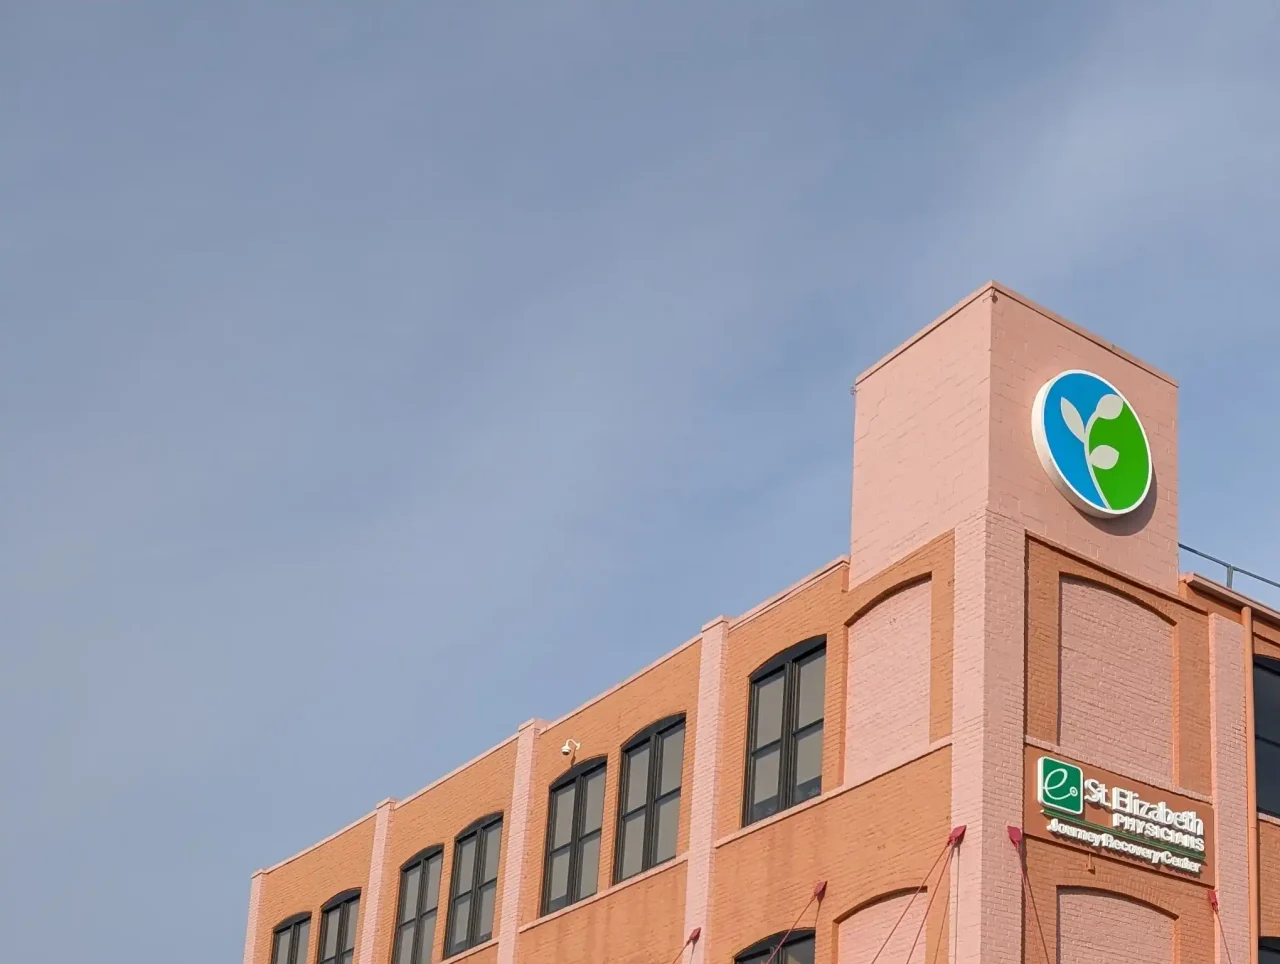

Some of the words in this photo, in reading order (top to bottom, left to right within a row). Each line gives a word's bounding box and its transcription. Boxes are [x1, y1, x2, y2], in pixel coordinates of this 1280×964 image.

[1111, 786, 1204, 836] Elizabeth
[1112, 813, 1205, 852] PHYSICIANS
[1046, 818, 1102, 846] Journey
[1100, 833, 1160, 863] Recovery
[1158, 850, 1202, 873] Center
